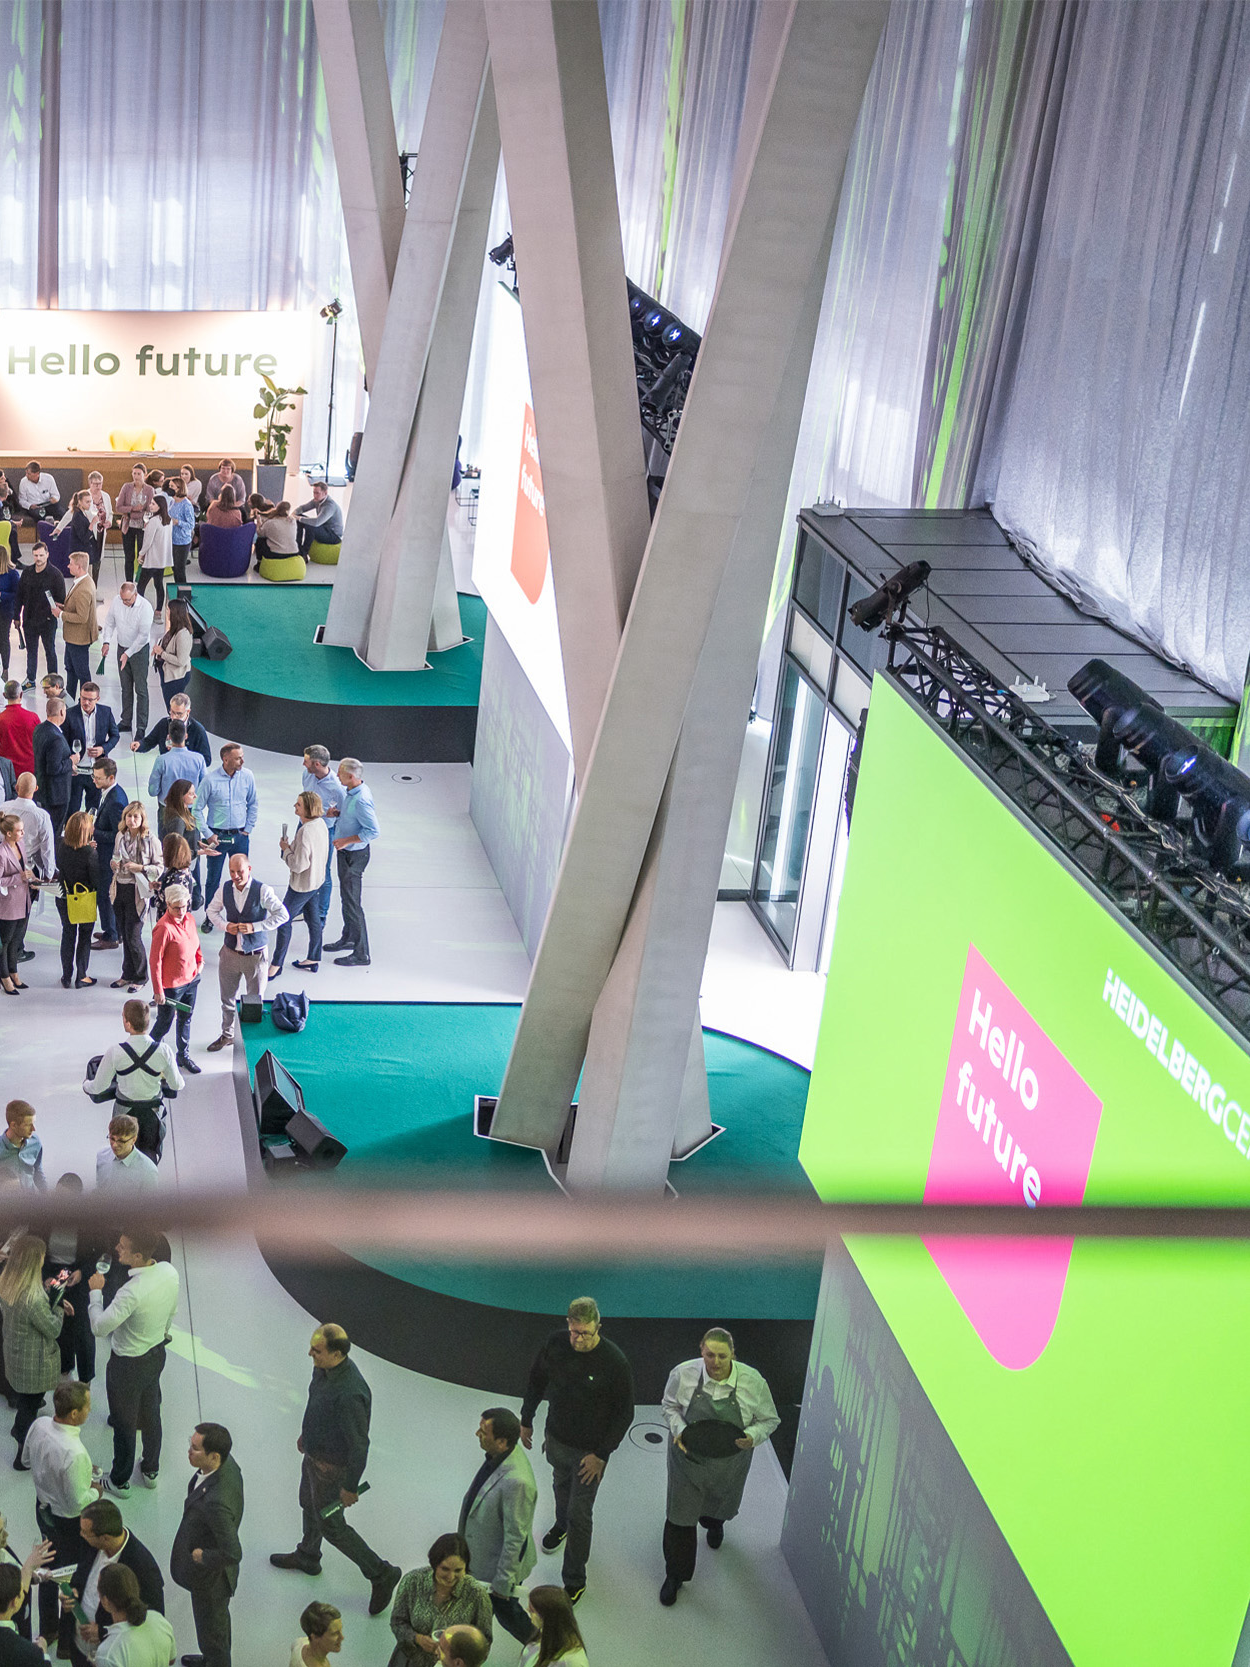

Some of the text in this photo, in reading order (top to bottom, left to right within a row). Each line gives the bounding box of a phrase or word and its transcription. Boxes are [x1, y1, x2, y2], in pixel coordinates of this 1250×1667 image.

[8, 344, 277, 376] Hello future
[968, 987, 1039, 1111] Hello
[1103, 967, 1250, 1160] HEIDELBERGCE
[956, 1061, 1041, 1208] future
